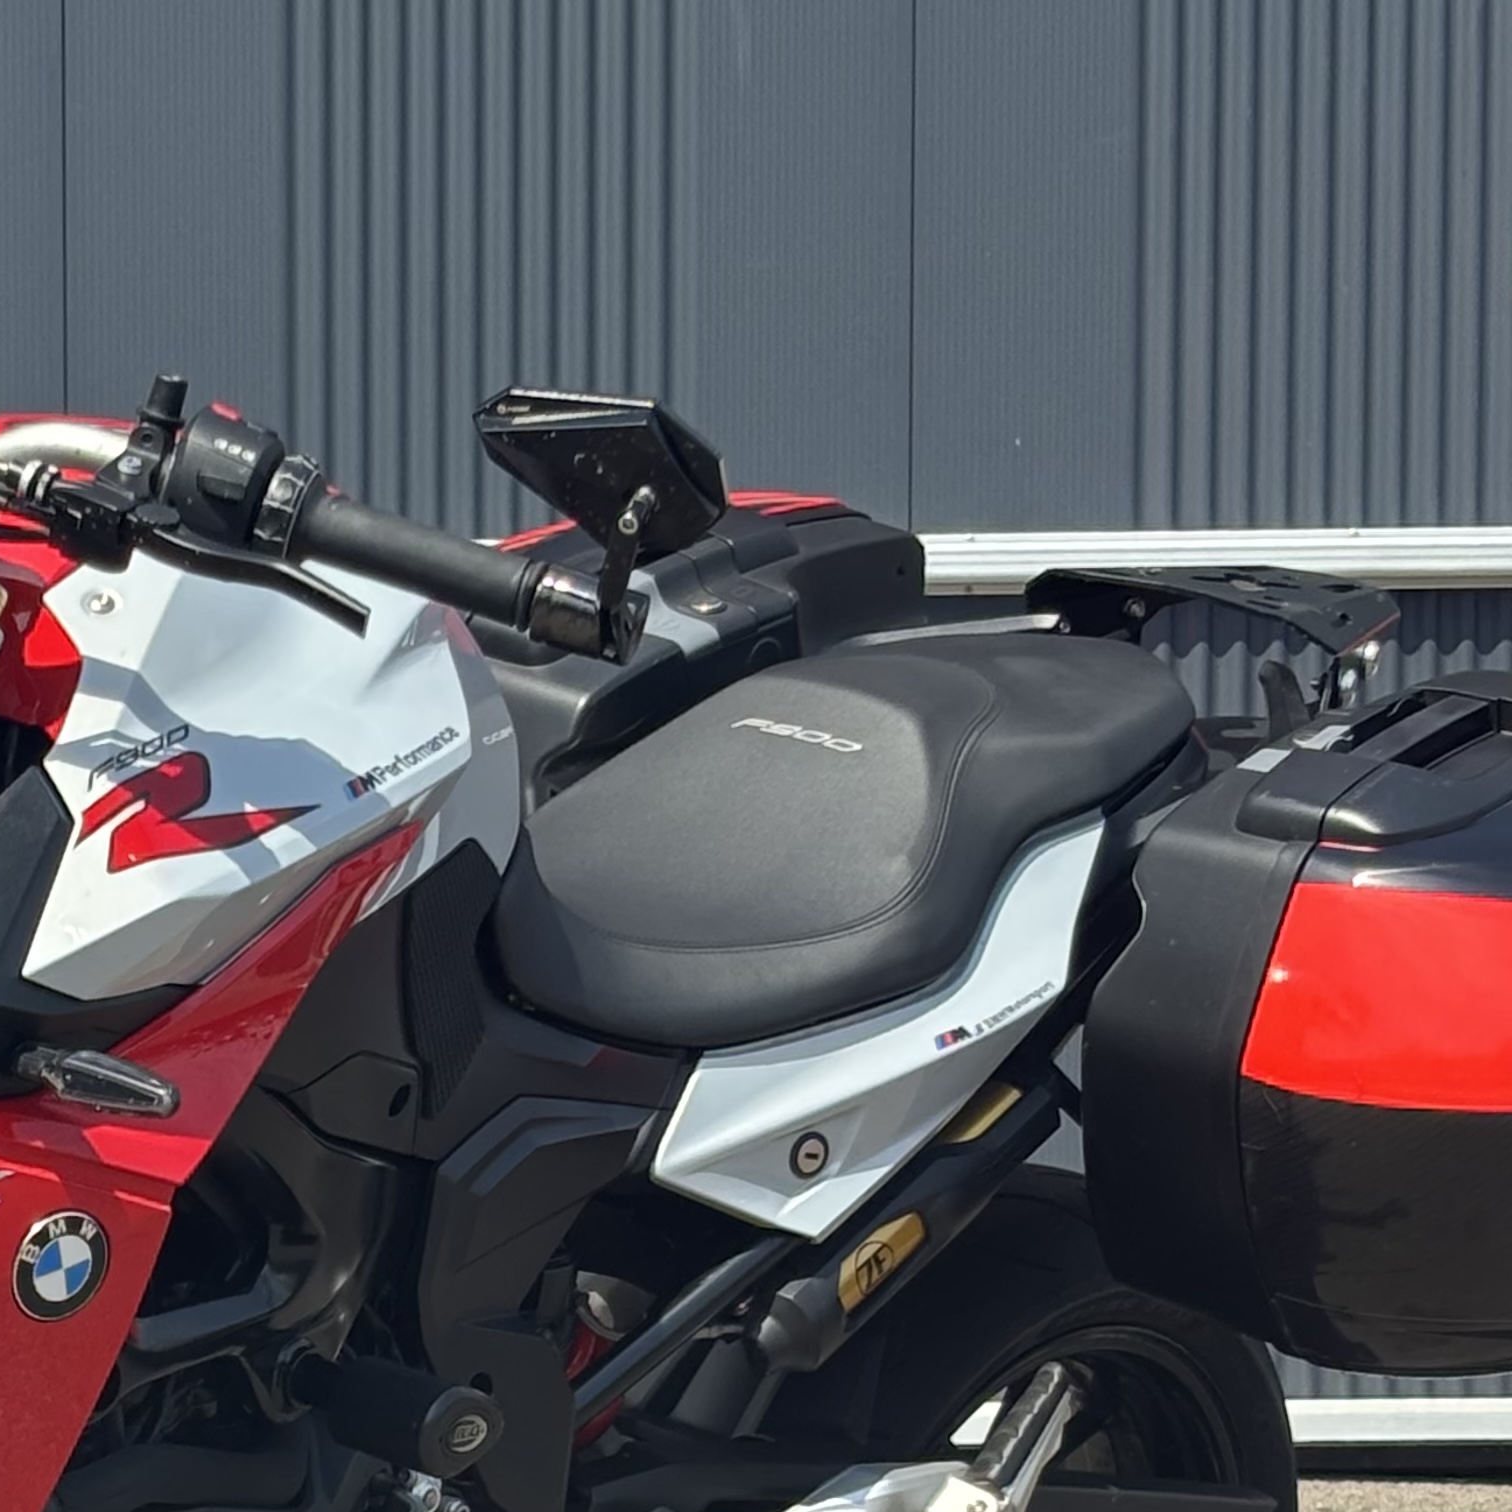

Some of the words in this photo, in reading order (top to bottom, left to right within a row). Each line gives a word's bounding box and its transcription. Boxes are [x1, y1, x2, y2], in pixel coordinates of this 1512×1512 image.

[87, 723, 189, 792] F900
[731, 718, 863, 752] F900
[21, 1219, 98, 1264] BMW
